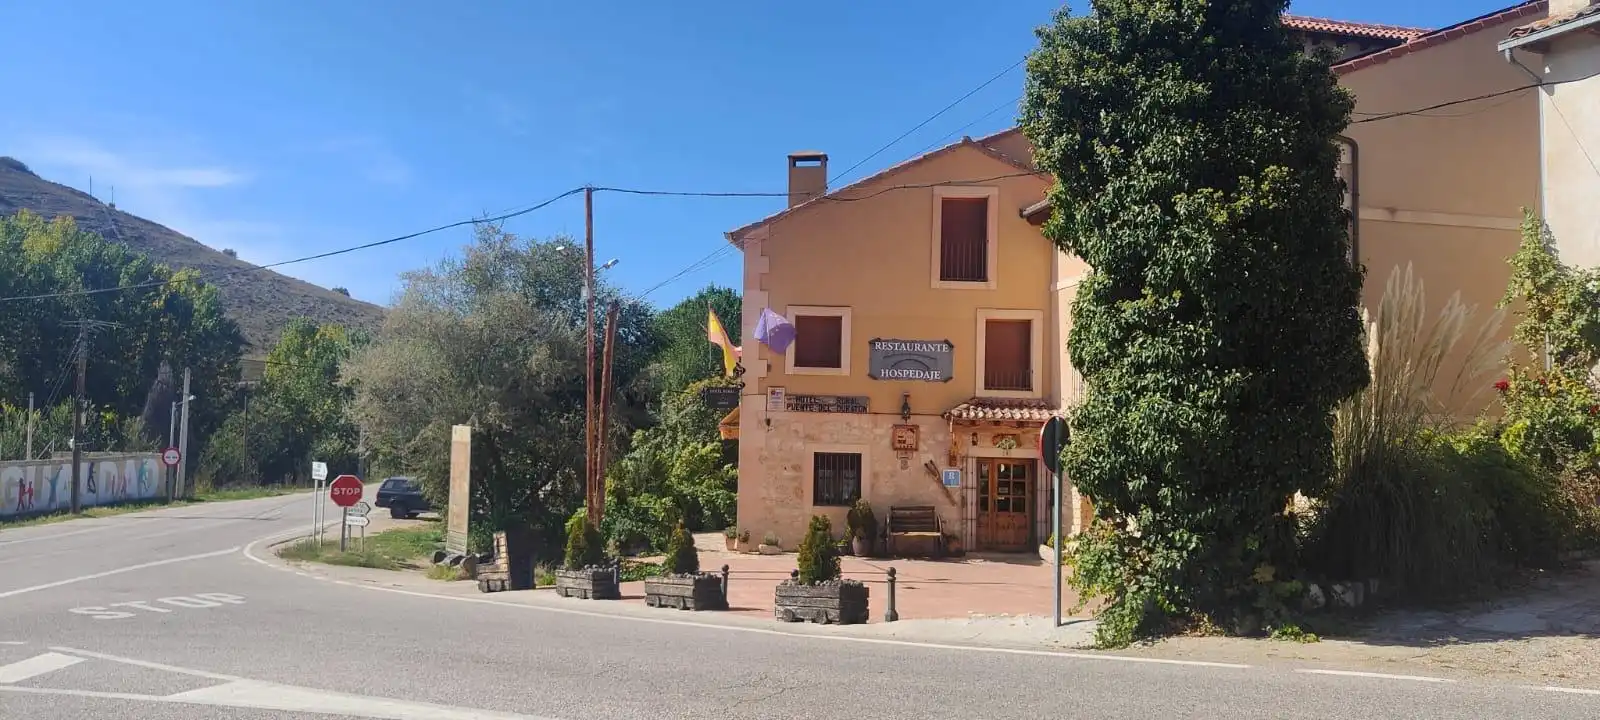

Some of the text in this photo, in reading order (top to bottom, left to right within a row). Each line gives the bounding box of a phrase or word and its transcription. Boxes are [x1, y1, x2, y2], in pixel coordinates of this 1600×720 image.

[874, 341, 949, 352] RESTAURANTE
[880, 369, 941, 381] HOSPEDAJE
[333, 487, 360, 496] STOP
[68, 592, 247, 620] STOP
